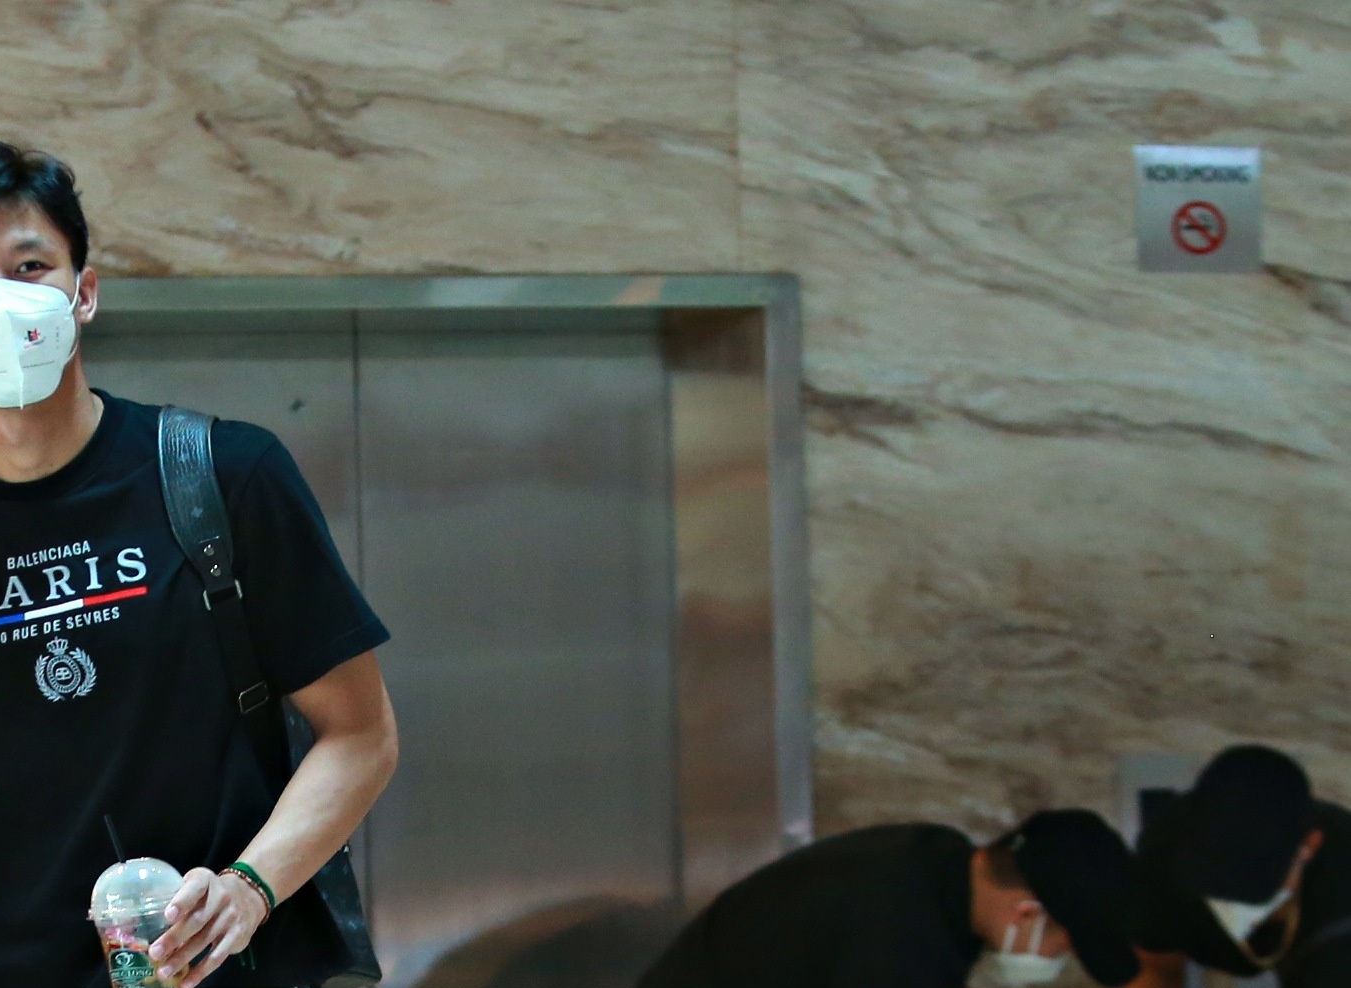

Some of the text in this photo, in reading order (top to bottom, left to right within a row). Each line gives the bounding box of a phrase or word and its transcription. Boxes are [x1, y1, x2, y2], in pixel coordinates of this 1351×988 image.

[7, 540, 91, 570] BALENCIAGA
[12, 623, 39, 641] RUE
[43, 619, 61, 635] DE
[66, 606, 120, 630] SEVRES
